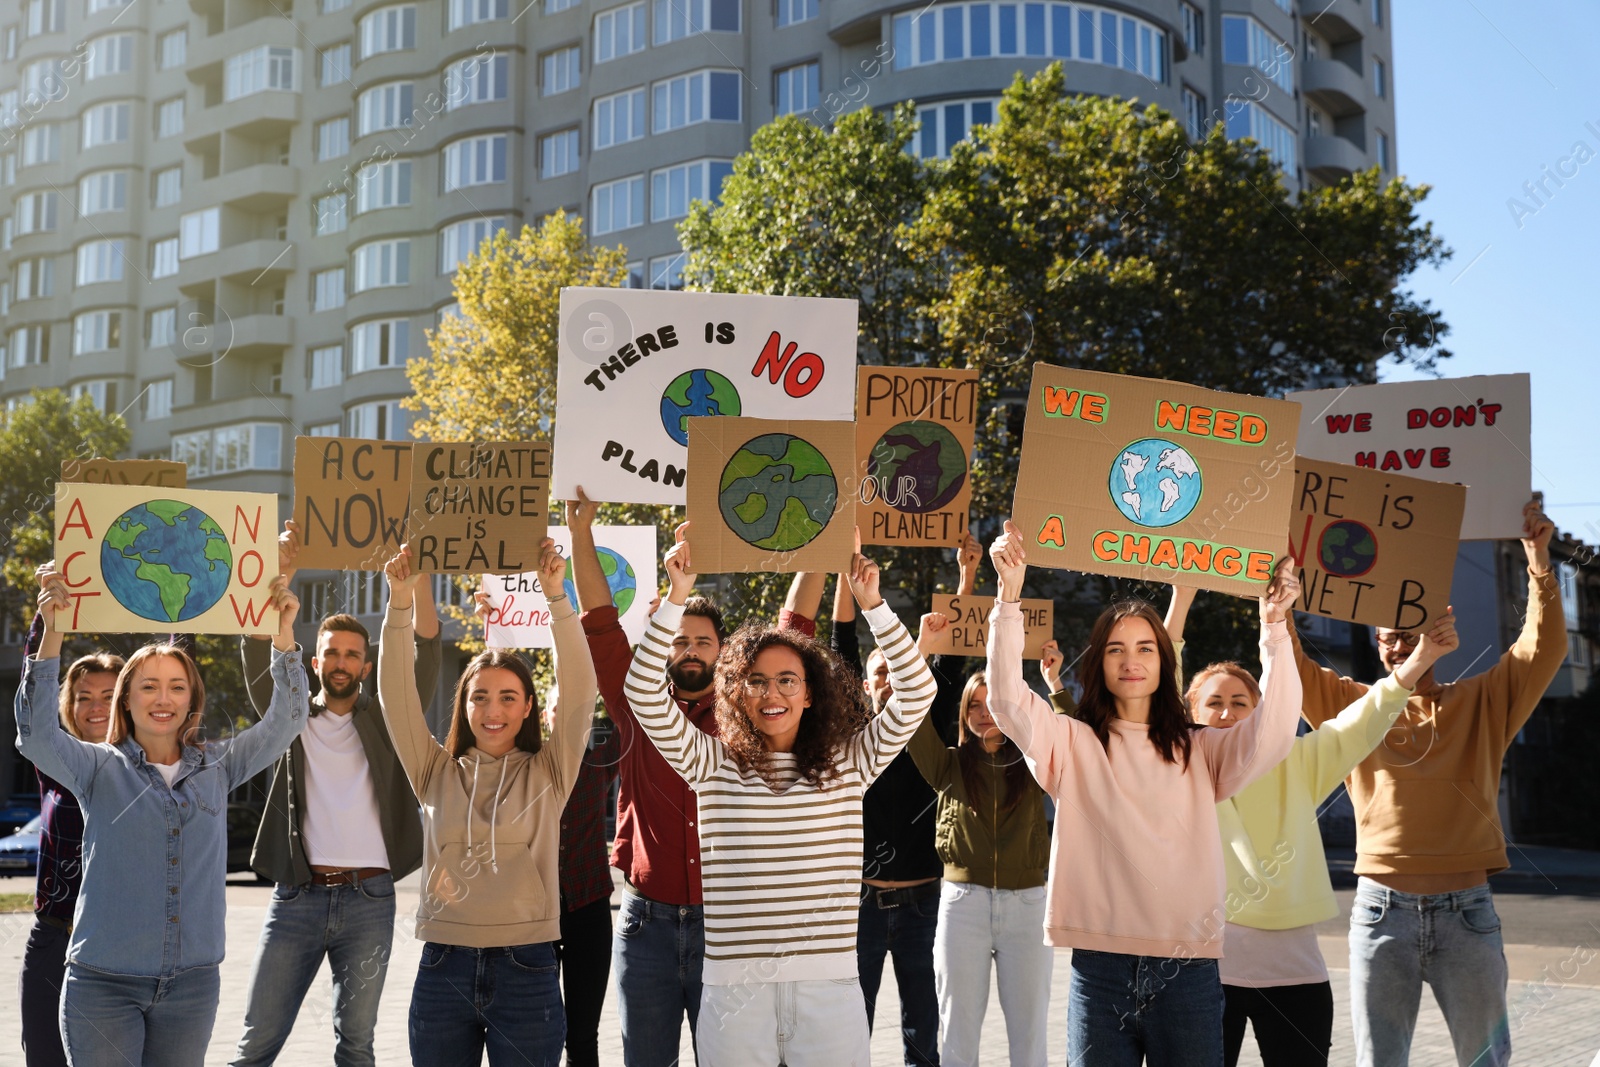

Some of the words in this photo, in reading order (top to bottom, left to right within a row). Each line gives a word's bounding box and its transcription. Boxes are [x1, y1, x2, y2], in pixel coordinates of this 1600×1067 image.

[584, 324, 679, 391] THERE
[704, 321, 736, 345] IS
[751, 330, 825, 398] NO
[866, 373, 979, 424] PROTECT
[1043, 385, 1107, 424] WE
[1156, 399, 1268, 444] NEED
[1325, 412, 1373, 435] WE
[1406, 398, 1503, 430] DON'T
[322, 440, 412, 482] ACT
[601, 440, 687, 488] PLAN
[1355, 446, 1451, 472] HAVE
[424, 485, 541, 517] CHANGE
[859, 474, 921, 508] OUR
[1295, 470, 1348, 518] RE
[303, 487, 411, 549] NOW
[418, 535, 523, 571] REAL
[1036, 515, 1066, 547] A
[1092, 530, 1273, 581] CHANGE
[500, 572, 543, 593] the
[1393, 579, 1429, 631] B
[1019, 608, 1048, 627] THE
